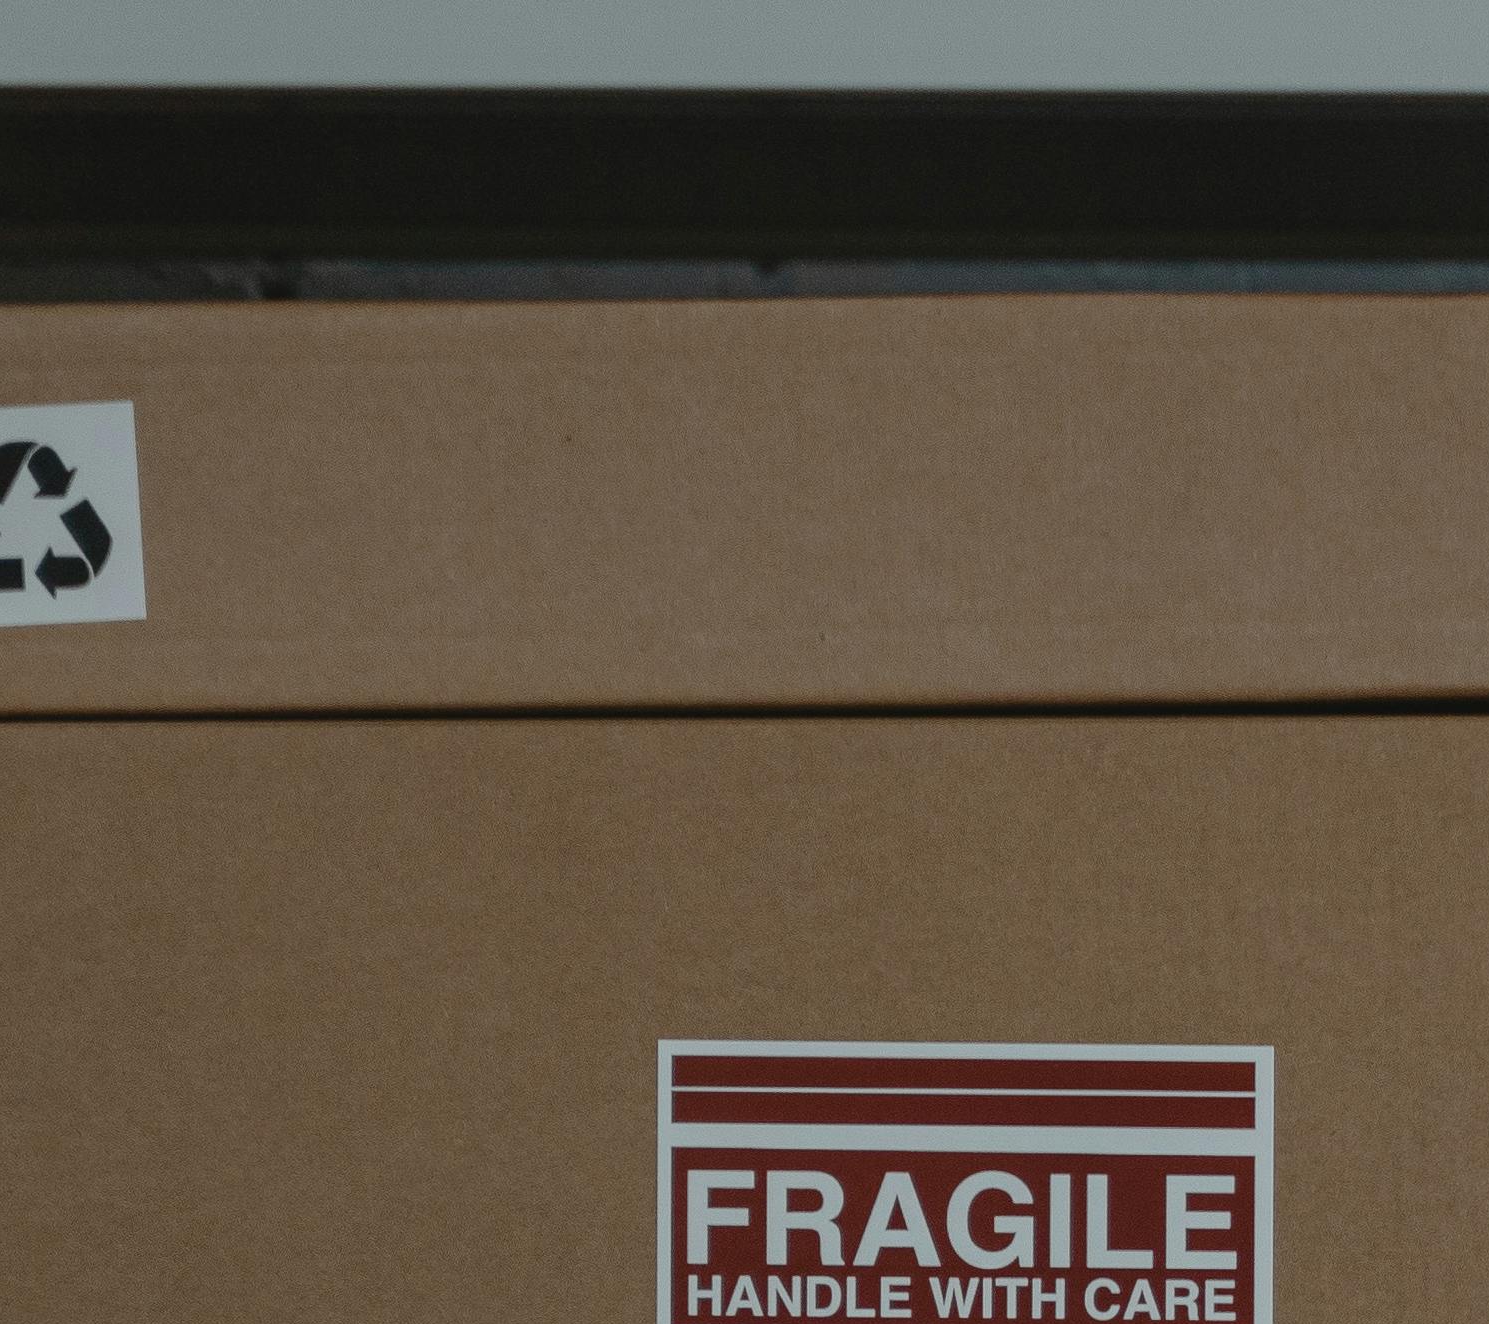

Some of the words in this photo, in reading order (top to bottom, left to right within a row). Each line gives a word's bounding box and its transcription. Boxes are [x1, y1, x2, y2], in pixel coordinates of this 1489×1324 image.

[686, 1169, 1238, 1270] FRAGILE
[687, 1274, 912, 1319] HANDLE
[928, 1276, 1066, 1320] WITH
[1084, 1277, 1237, 1322] CARE
